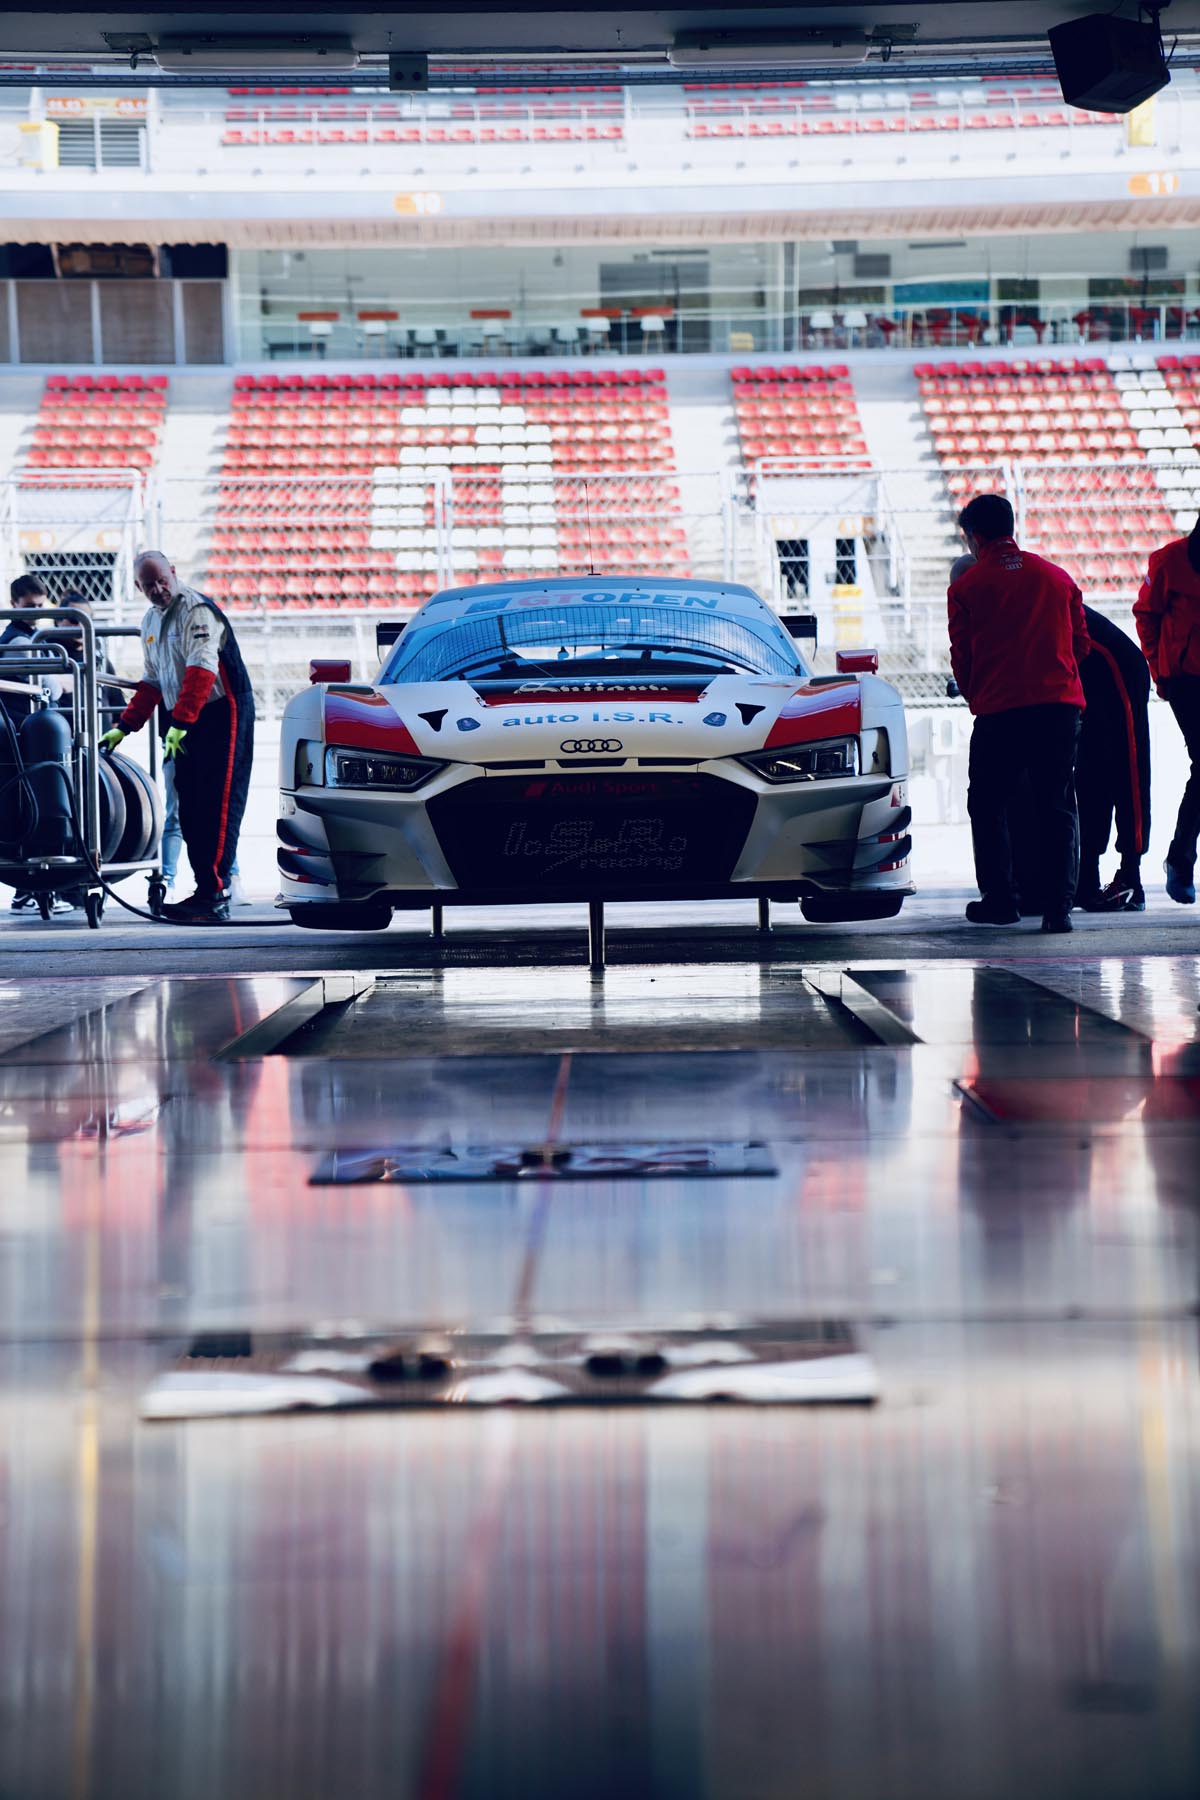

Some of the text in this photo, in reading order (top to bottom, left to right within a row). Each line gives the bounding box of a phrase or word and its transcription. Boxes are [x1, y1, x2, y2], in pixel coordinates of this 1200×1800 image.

[502, 711, 684, 727] auto I.S.R.
[551, 780, 597, 793] Audi
[604, 781, 657, 796] Sport
